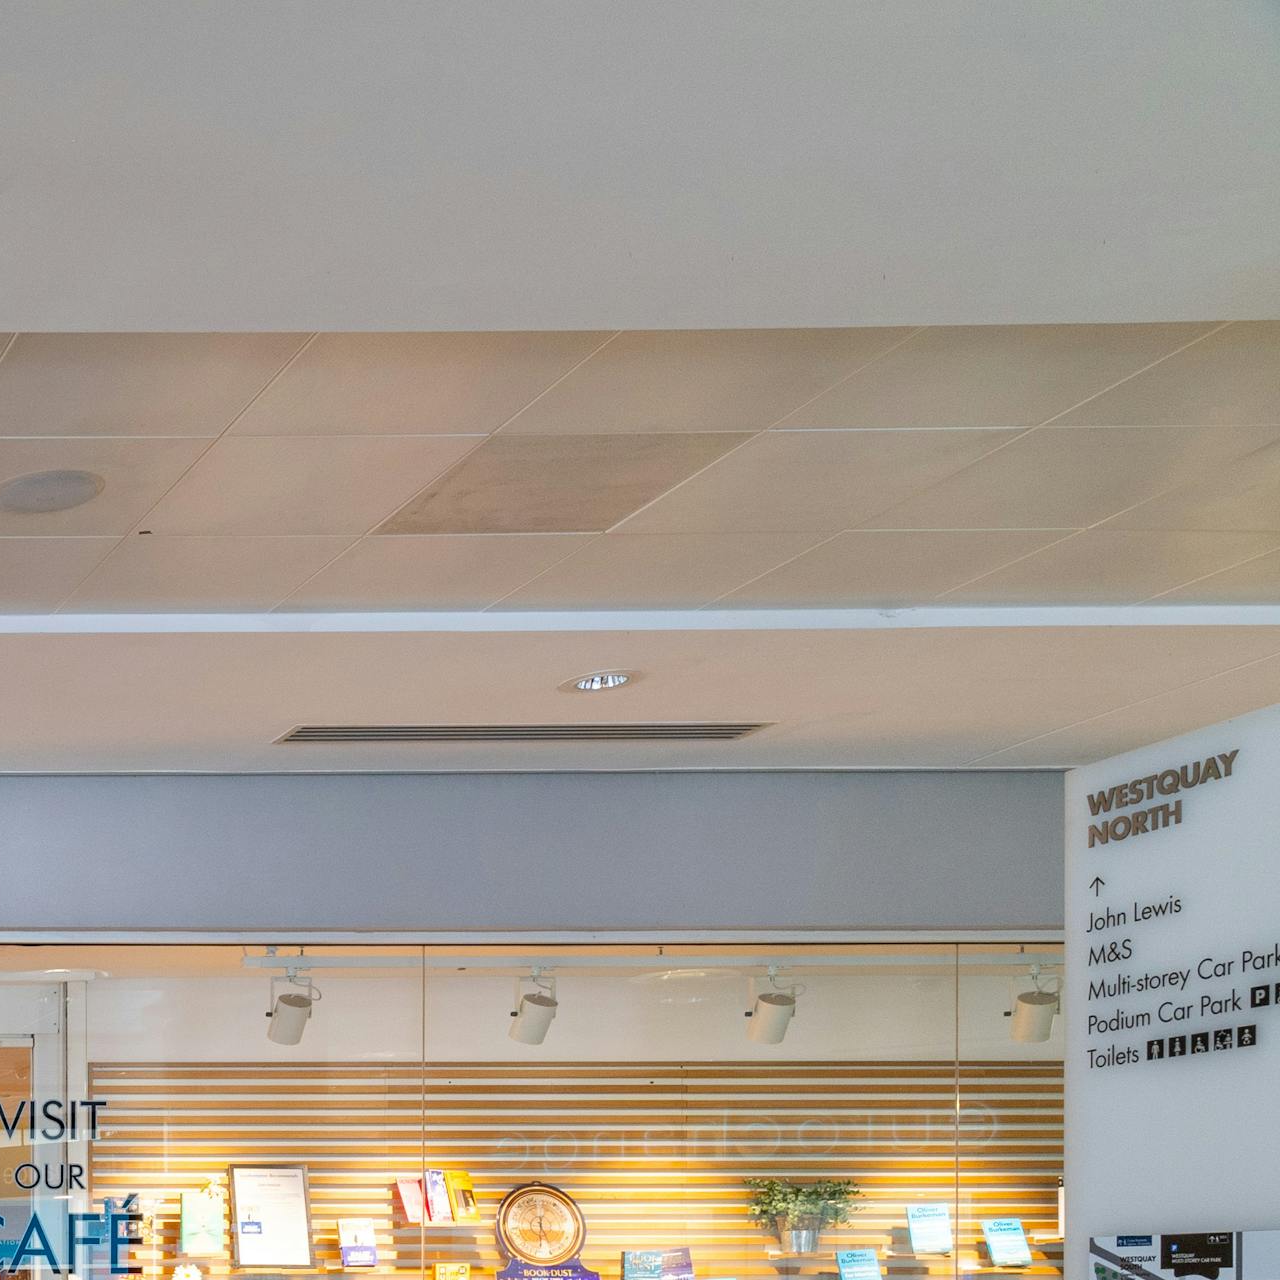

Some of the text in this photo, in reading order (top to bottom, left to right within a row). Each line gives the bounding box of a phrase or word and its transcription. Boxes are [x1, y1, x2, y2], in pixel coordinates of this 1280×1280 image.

[1087, 749, 1239, 816] WESTQUAY
[1088, 800, 1182, 848] NORTH
[1086, 896, 1182, 932] John Lewis
[1089, 938, 1132, 967] M&S
[1088, 943, 1280, 1000] Multi-storey Car Park
[1088, 988, 1242, 1035] Podium Car Park
[1087, 1046, 1139, 1069] Toilets
[15, 1163, 86, 1190] OUR
[549, 1269, 573, 1277] DUST
